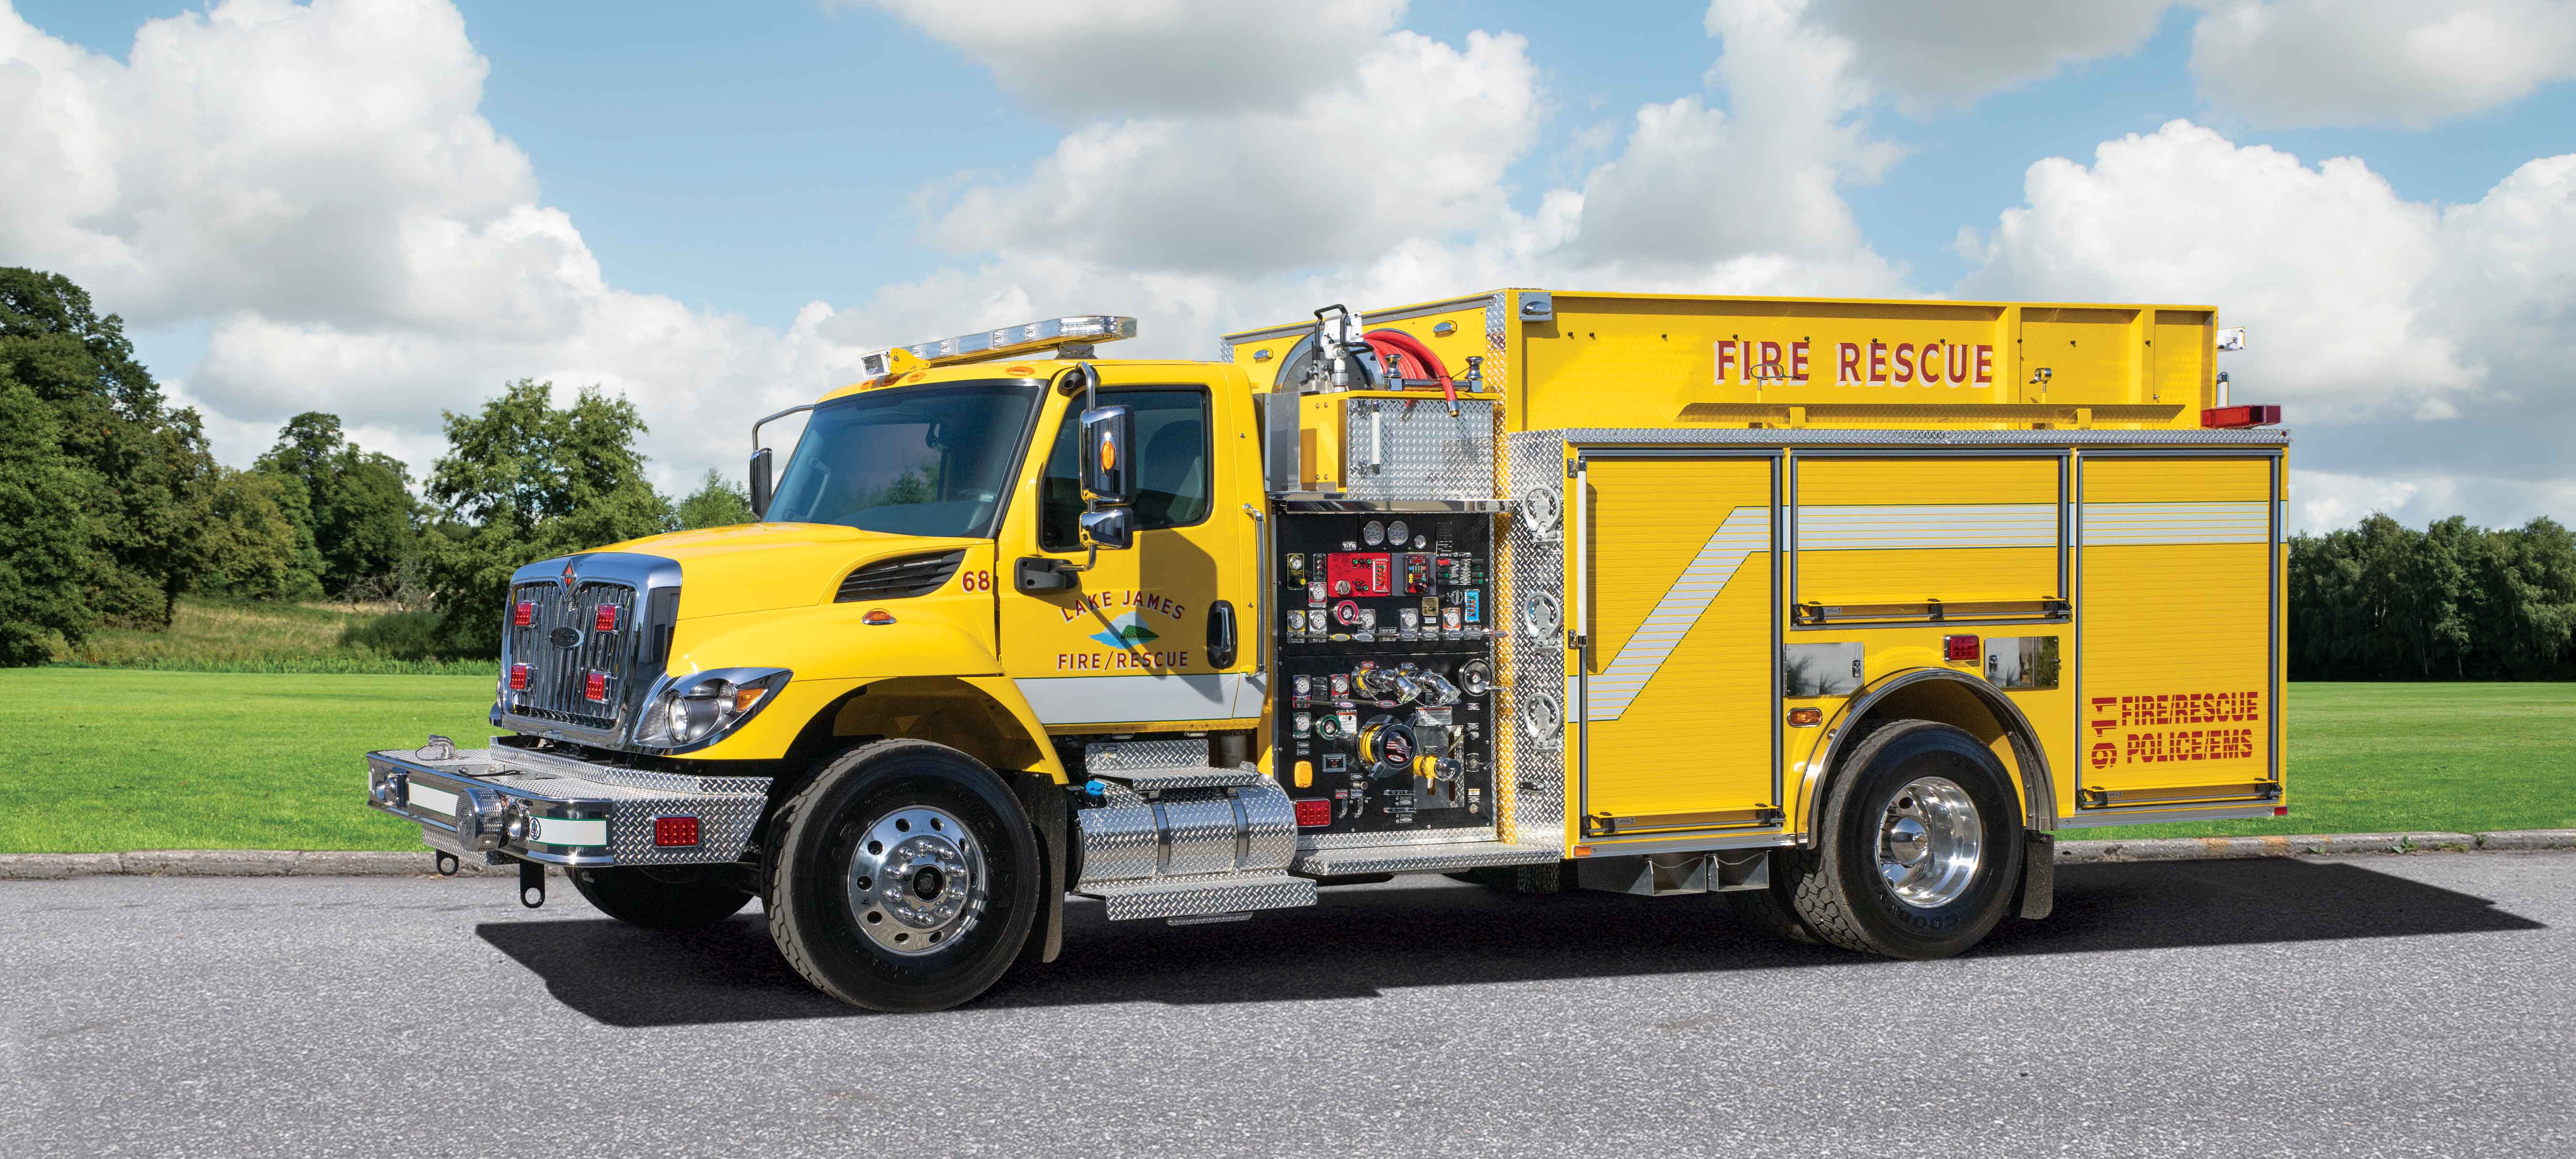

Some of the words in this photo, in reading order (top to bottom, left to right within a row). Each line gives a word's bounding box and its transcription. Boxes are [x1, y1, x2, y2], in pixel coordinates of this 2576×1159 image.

[1713, 341, 1811, 386] FIRE
[1834, 342, 1994, 388] RESCUE
[962, 570, 990, 592] 68
[1061, 591, 1113, 622] LAKE
[1122, 590, 1186, 621] JAMES
[1057, 651, 1188, 671] FIRE/RESCUE
[2122, 692, 2258, 726] FIRE/RESCUE
[2091, 697, 2117, 769] 911
[2127, 729, 2253, 764] POLICE/EMS
